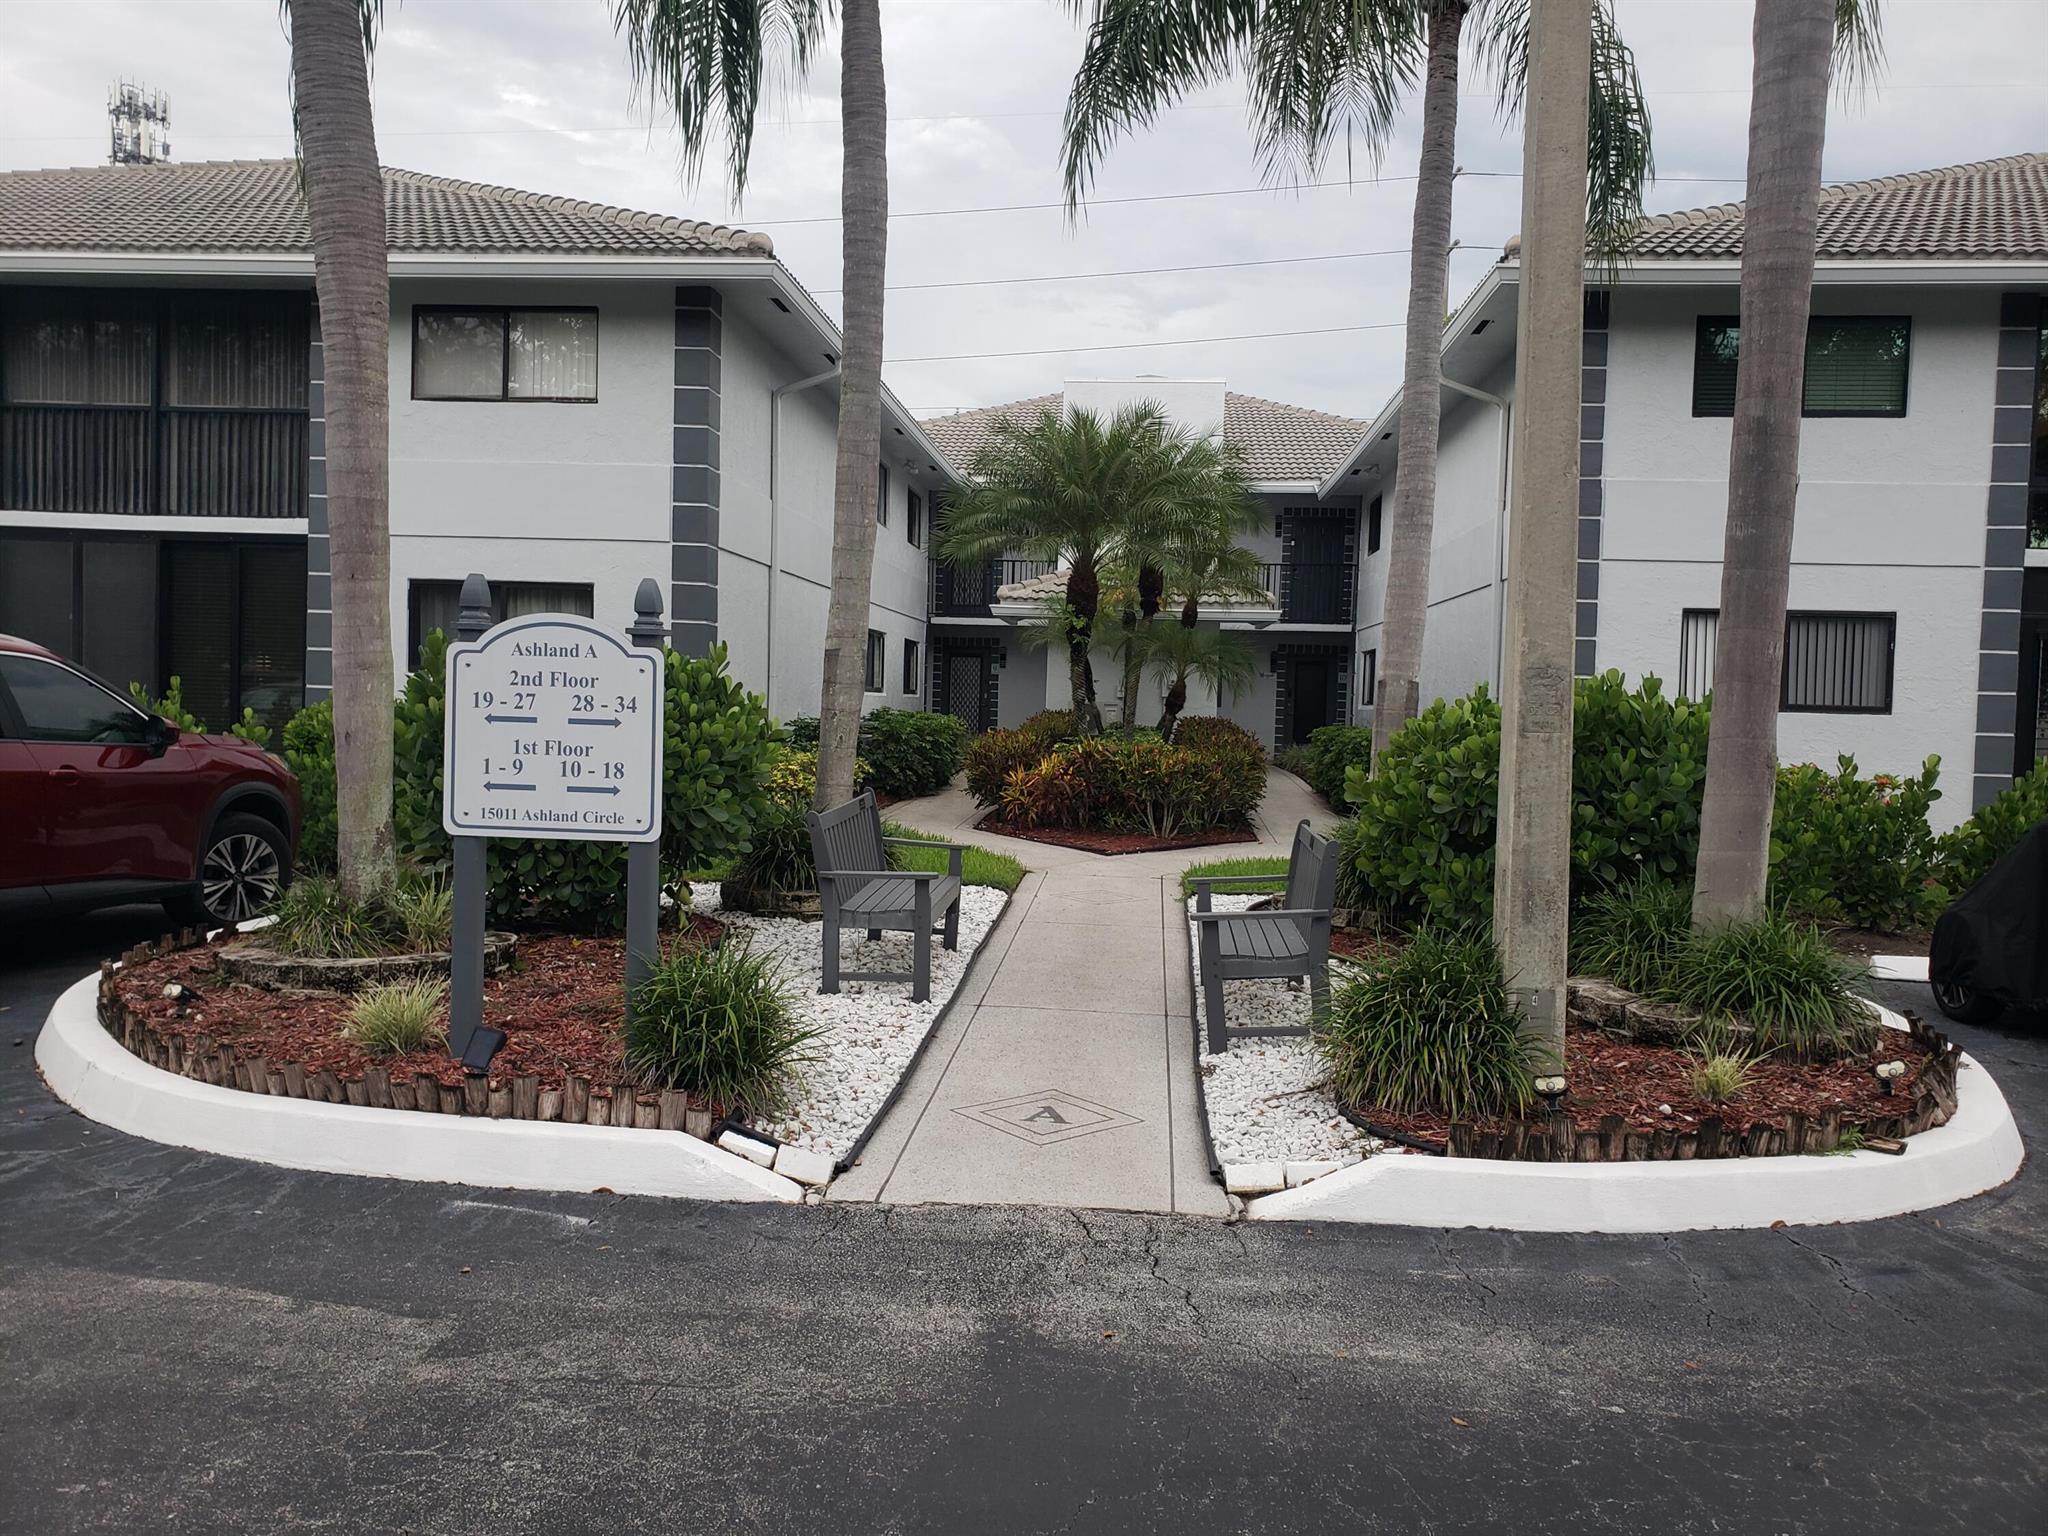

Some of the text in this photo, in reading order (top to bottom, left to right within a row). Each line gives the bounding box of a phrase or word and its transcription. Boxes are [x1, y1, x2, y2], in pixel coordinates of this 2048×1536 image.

[511, 642, 598, 659] Ashland A
[510, 670, 600, 689] 2nd Floor
[472, 691, 494, 709] 19
[513, 693, 537, 711] 27
[571, 694, 595, 713] 28
[614, 696, 637, 714] 34
[513, 739, 594, 758] 1st Floor
[483, 758, 490, 775] 1
[512, 758, 524, 776] 9
[560, 761, 582, 778] 10
[603, 762, 625, 780] 18
[480, 807, 625, 825] 15011 Ashland Circle
[1019, 1105, 1073, 1125] A
